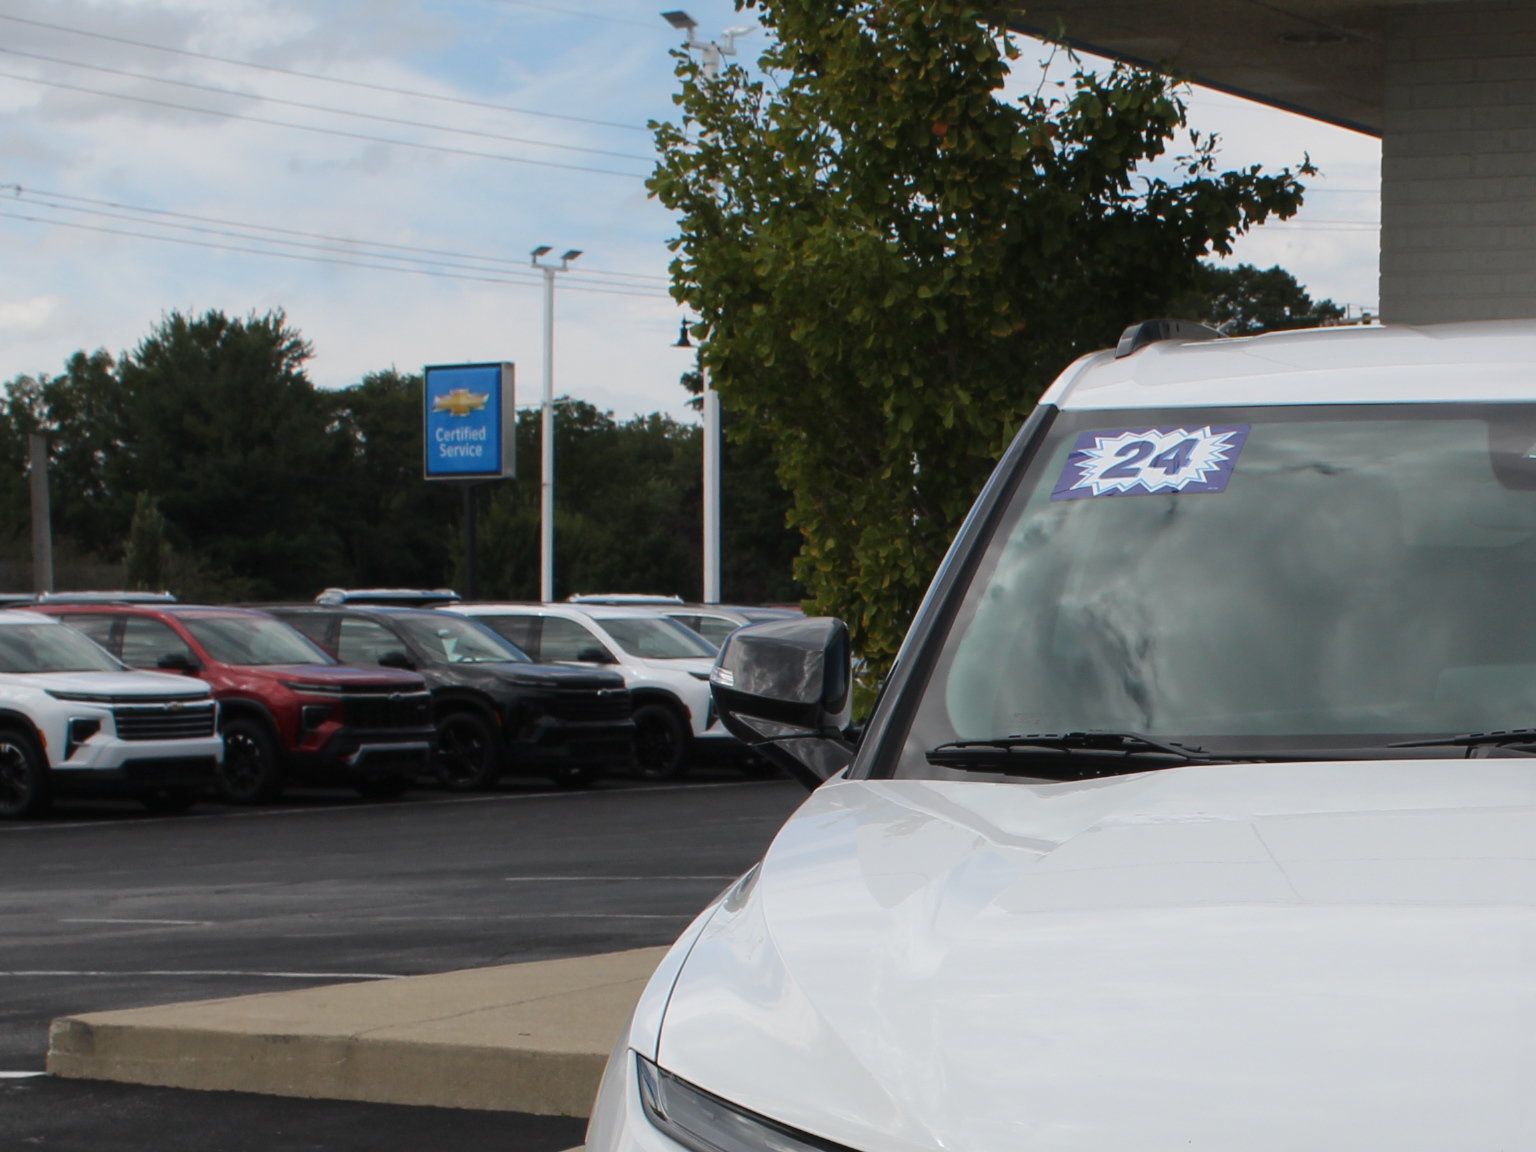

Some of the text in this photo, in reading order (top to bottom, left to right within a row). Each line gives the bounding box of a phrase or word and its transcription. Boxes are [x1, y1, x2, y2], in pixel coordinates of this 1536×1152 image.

[435, 426, 487, 442] Certified
[439, 443, 482, 457] Service
[1100, 438, 1200, 479] 24
